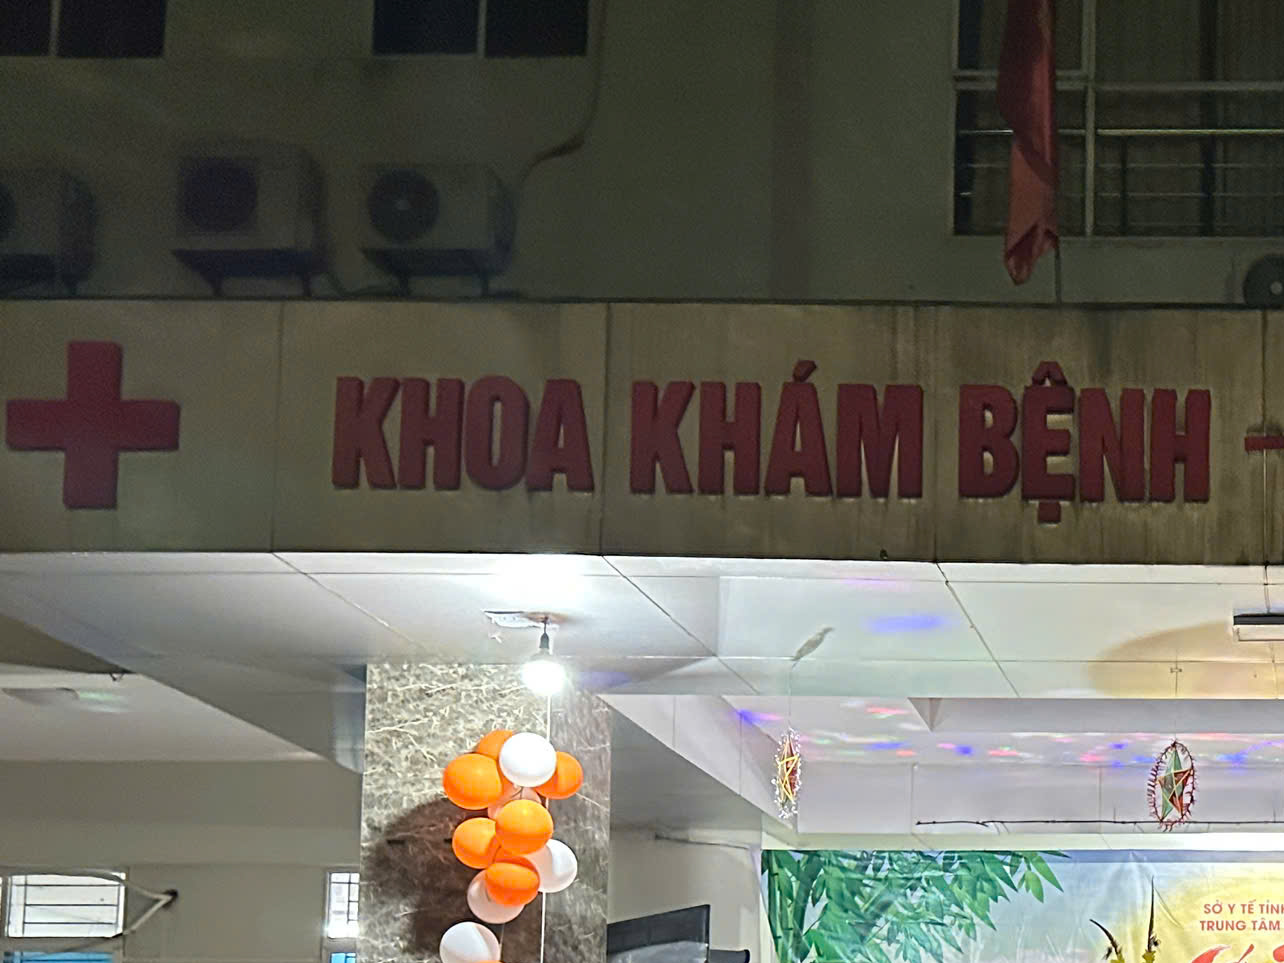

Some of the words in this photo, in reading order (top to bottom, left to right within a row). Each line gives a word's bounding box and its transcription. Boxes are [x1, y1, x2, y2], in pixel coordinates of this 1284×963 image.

[331, 374, 594, 492] KHOA
[628, 359, 924, 500] KHÁM
[957, 360, 1212, 524] BỆNH
[1203, 900, 1223, 914] SỞ
[1227, 903, 1236, 914] Y
[1240, 899, 1257, 914] TẾ
[1200, 920, 1247, 931] TRUNG
[1251, 917, 1281, 931] TÂM
